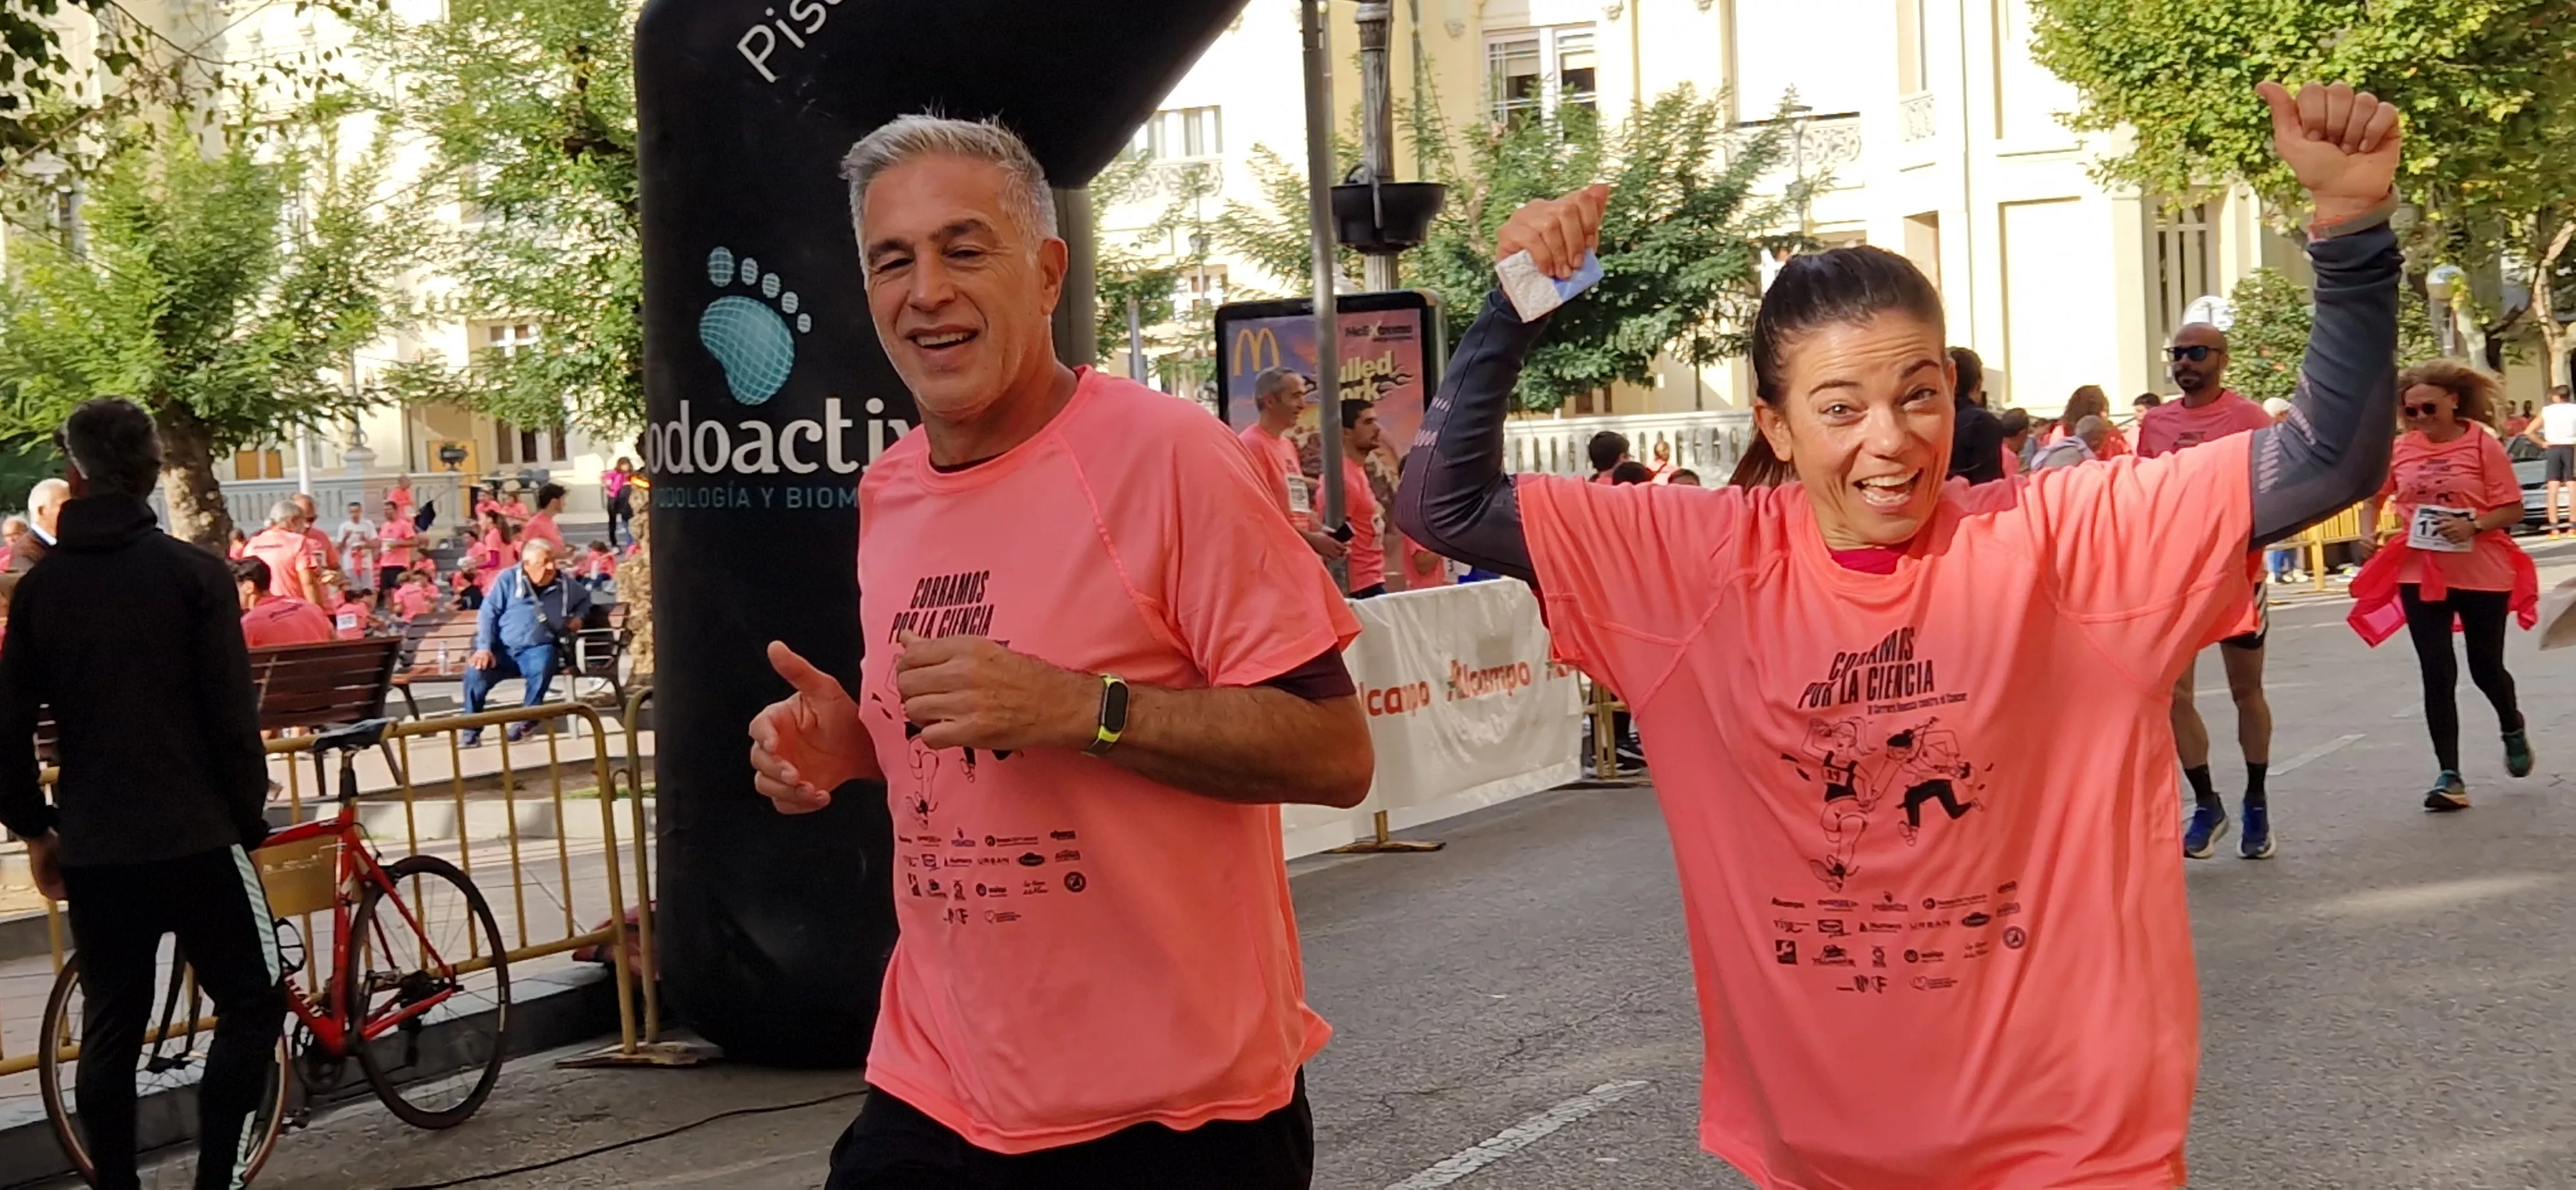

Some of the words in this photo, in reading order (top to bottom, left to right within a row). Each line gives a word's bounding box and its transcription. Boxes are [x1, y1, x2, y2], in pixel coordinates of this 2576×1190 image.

[737, 0, 844, 83] Pis
[761, 487, 775, 508] Y
[910, 570, 990, 610] CORRAMOS
[888, 611, 919, 645] POR
[936, 603, 994, 639] CIENCIA
[1446, 659, 1531, 703] Alcampo
[1797, 679, 1837, 709] POR
[1839, 669, 1859, 704] LA
[1867, 659, 1935, 701] CIENCIA
